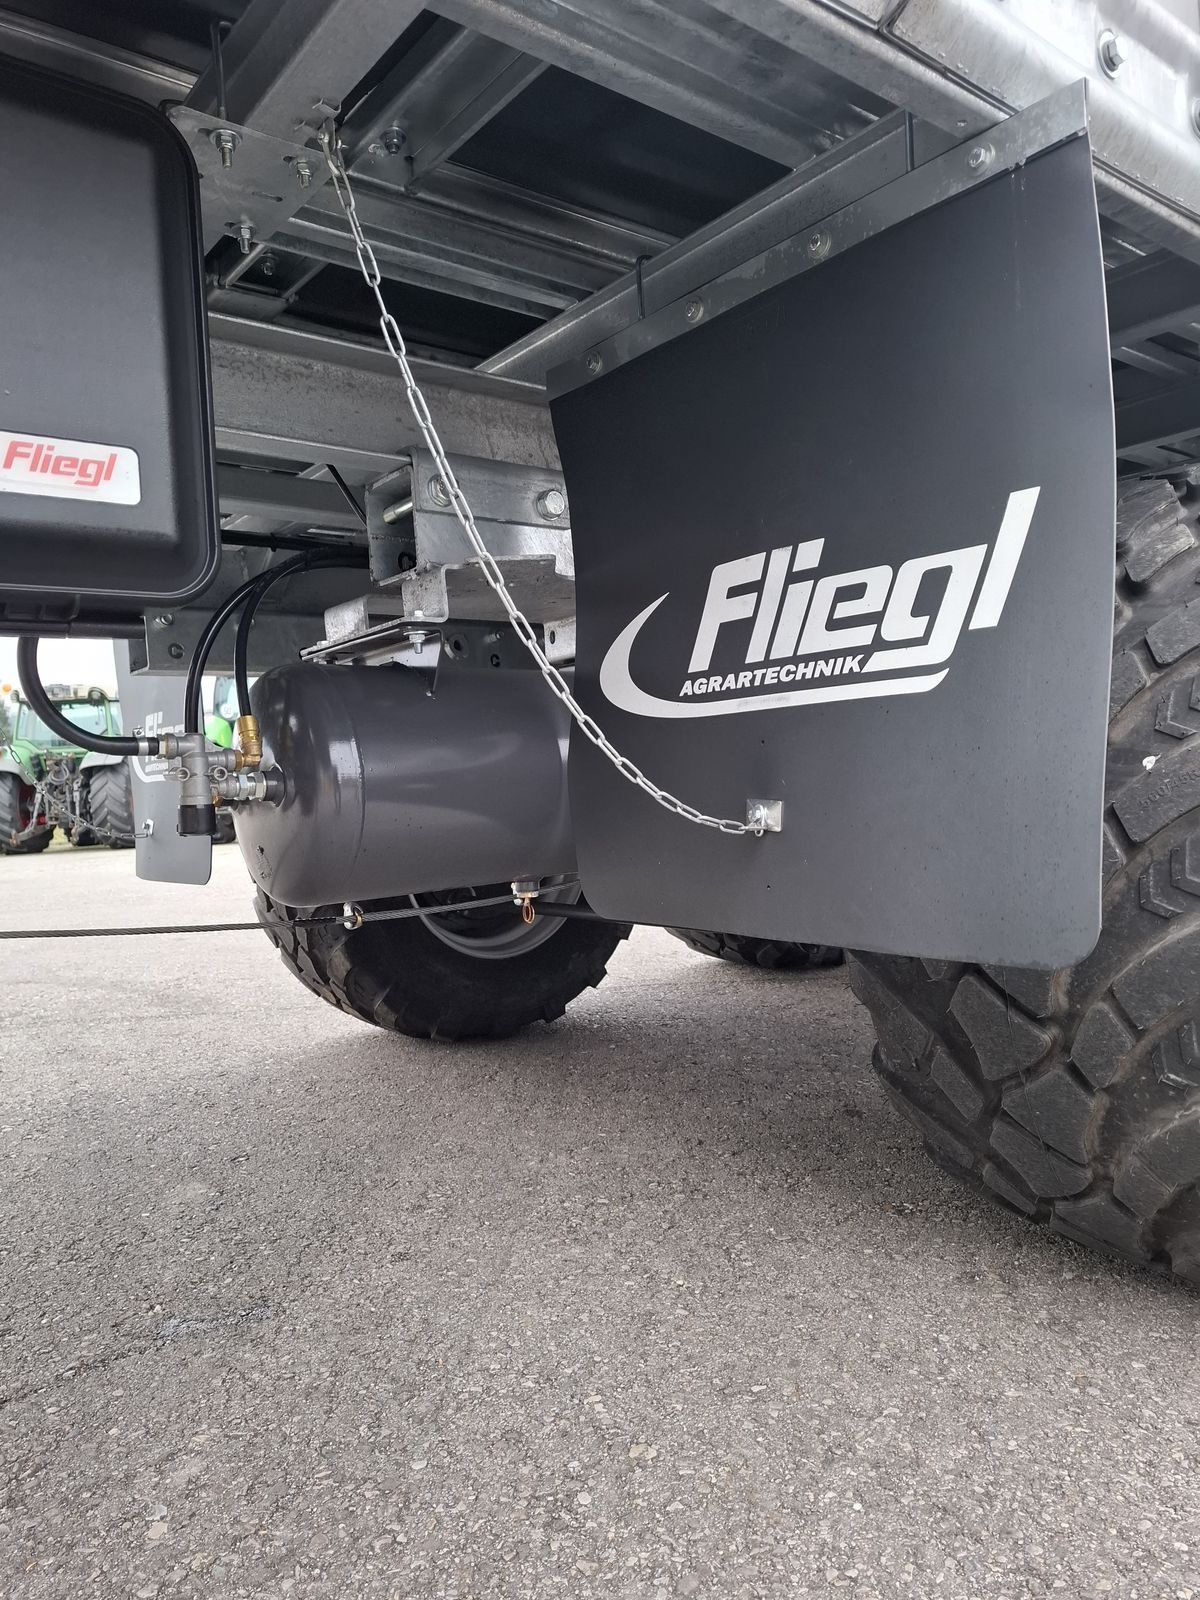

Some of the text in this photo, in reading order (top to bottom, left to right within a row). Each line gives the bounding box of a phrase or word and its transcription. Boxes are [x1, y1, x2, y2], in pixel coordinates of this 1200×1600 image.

[3, 440, 117, 487] Fliegl
[688, 486, 1041, 673] Fliegl
[679, 654, 864, 697] AGRARTECHNIK
